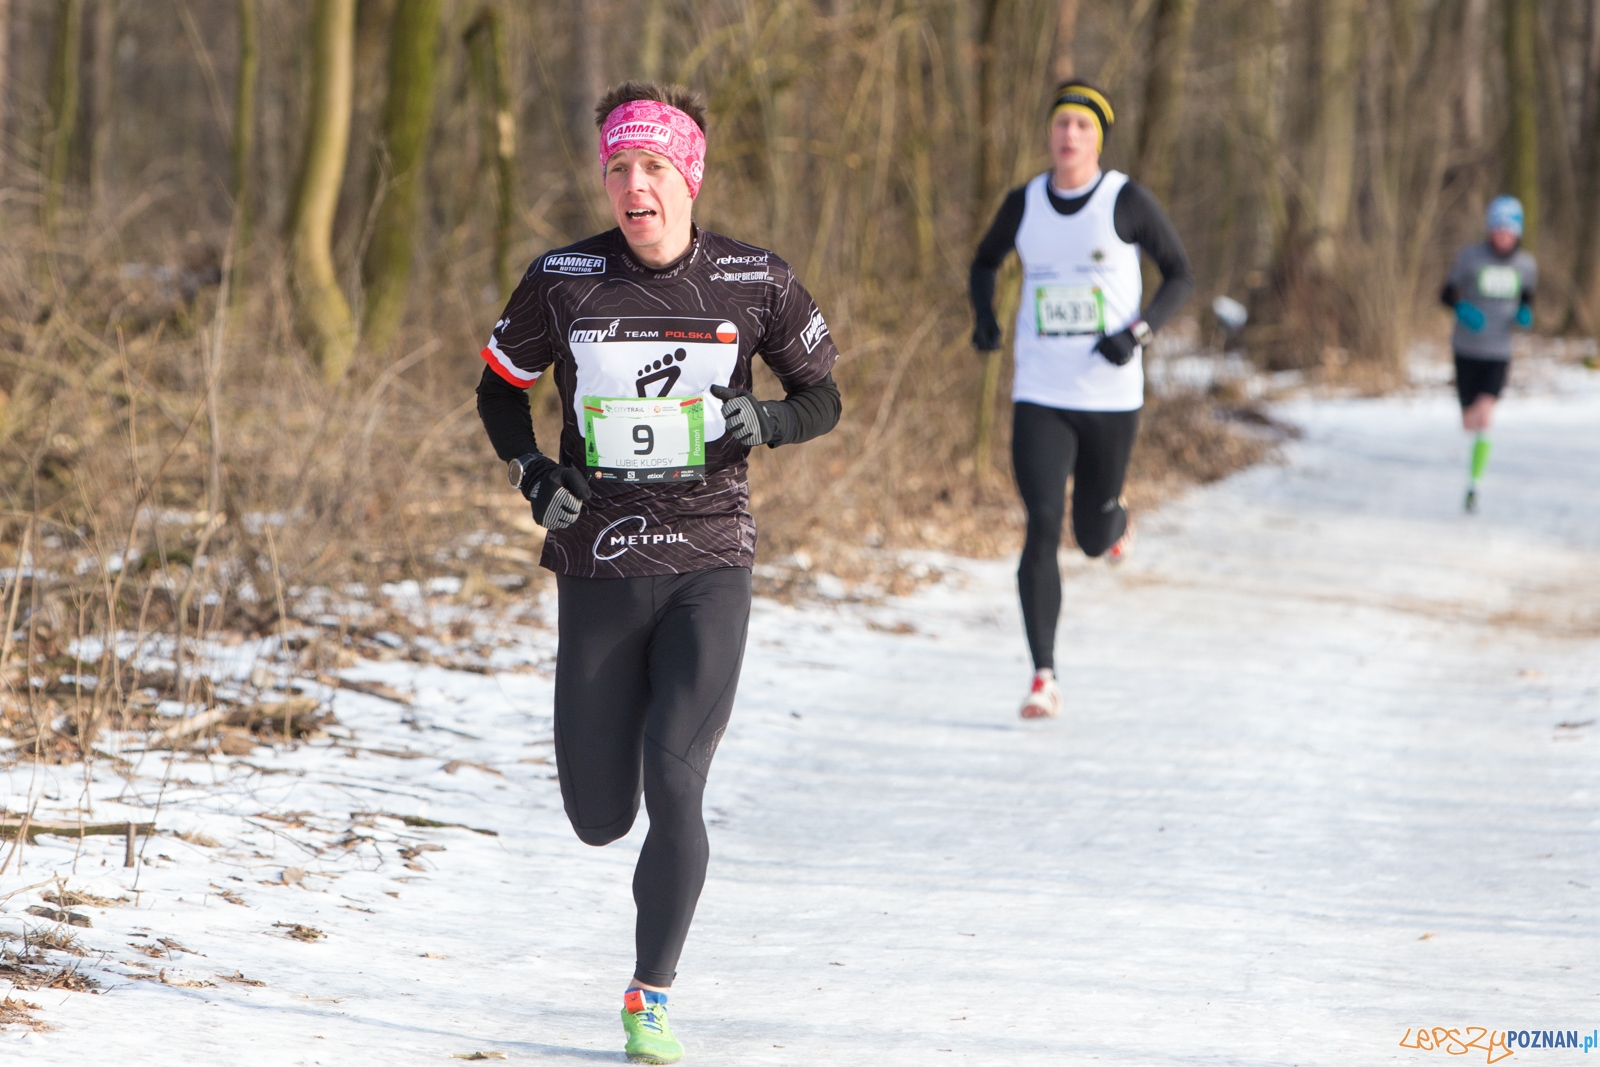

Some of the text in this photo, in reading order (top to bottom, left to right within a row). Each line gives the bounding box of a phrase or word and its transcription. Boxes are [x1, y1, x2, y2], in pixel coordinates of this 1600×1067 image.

[609, 124, 669, 140] HAMMER
[547, 256, 603, 268] HAMMER
[716, 254, 769, 265] rehasport
[624, 330, 659, 338] TEAM
[665, 331, 713, 340] POLSKA
[632, 424, 655, 455] 9
[693, 429, 701, 457] Poznań
[640, 457, 674, 467] KLOPSY
[610, 532, 689, 546] METPOL
